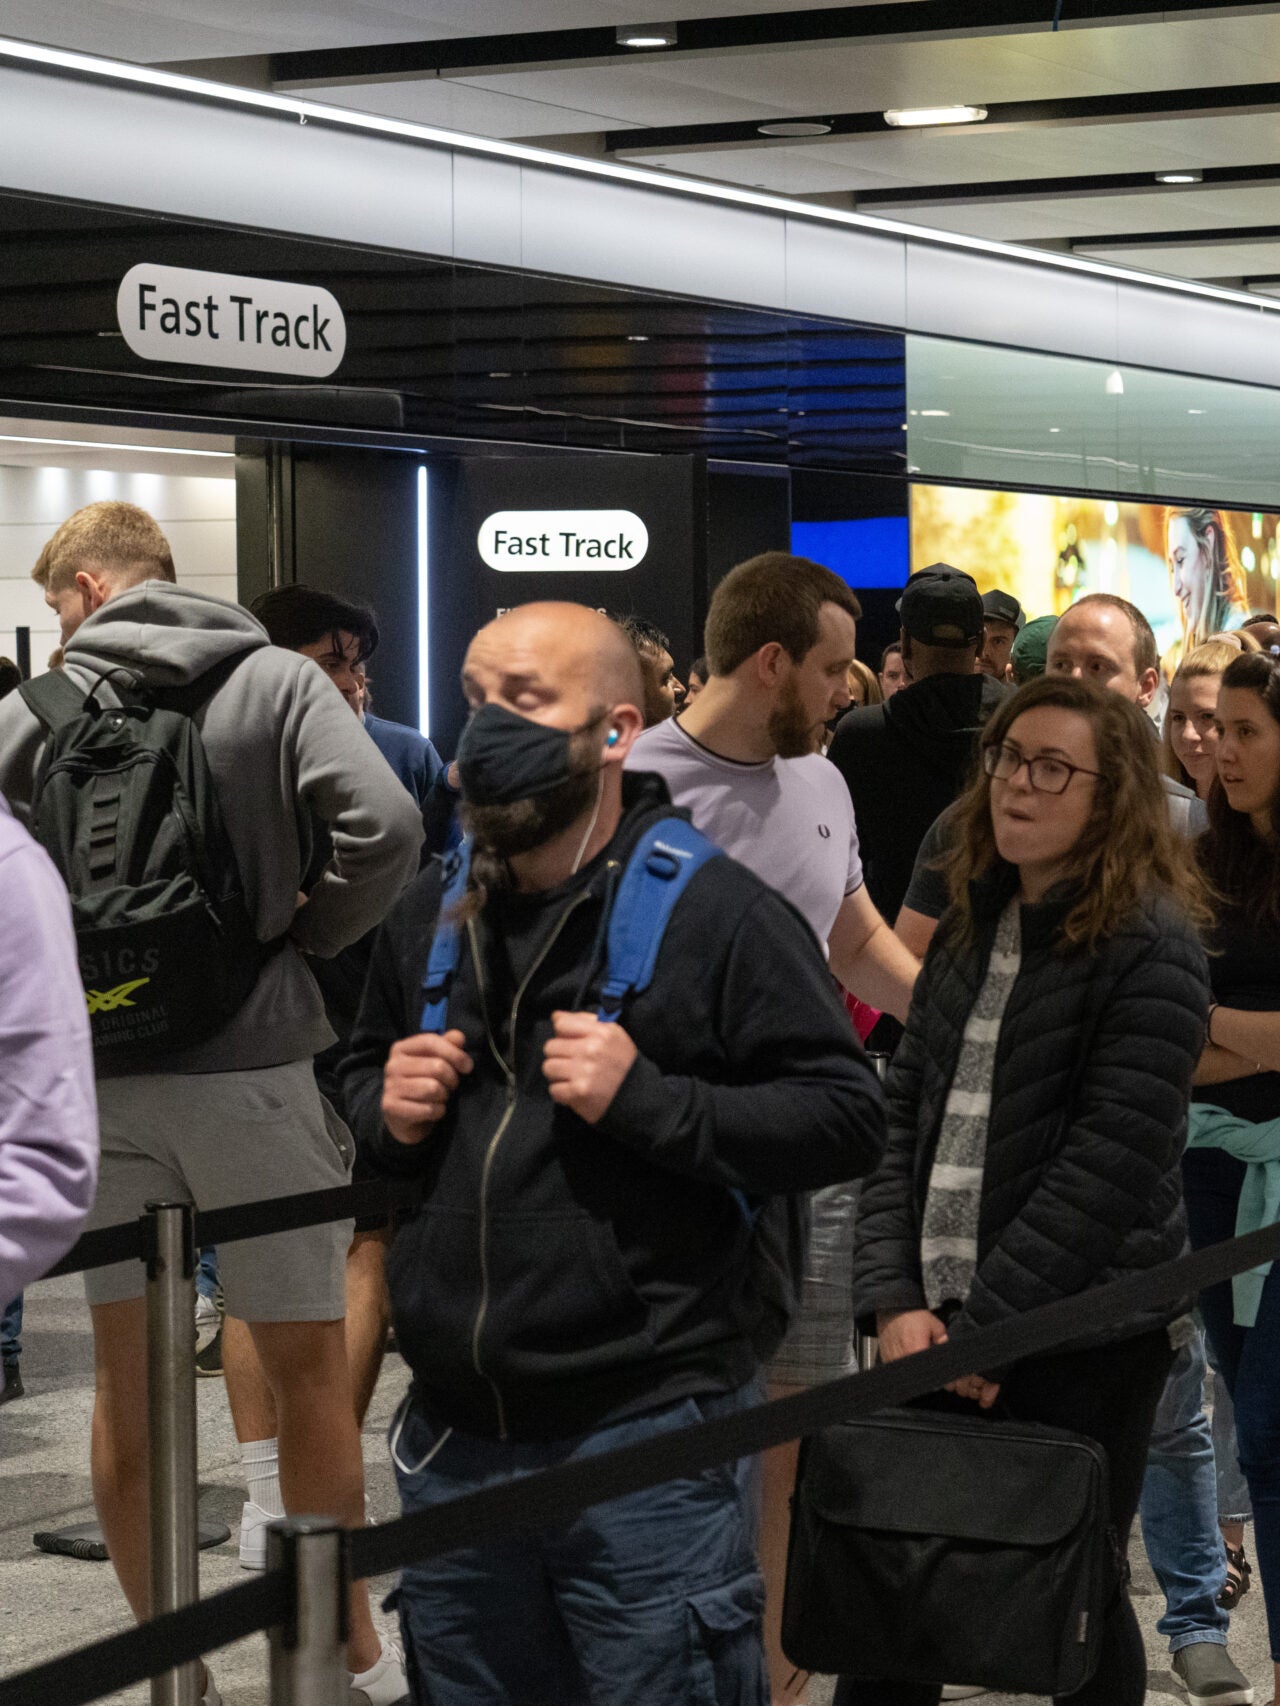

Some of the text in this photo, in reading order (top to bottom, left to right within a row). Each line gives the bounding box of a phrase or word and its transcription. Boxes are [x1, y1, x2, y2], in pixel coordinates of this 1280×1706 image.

[138, 283, 332, 352] Fast Track
[493, 530, 634, 559] Fast Track
[80, 948, 159, 980] SICS
[137, 1020, 169, 1038] CLUB
